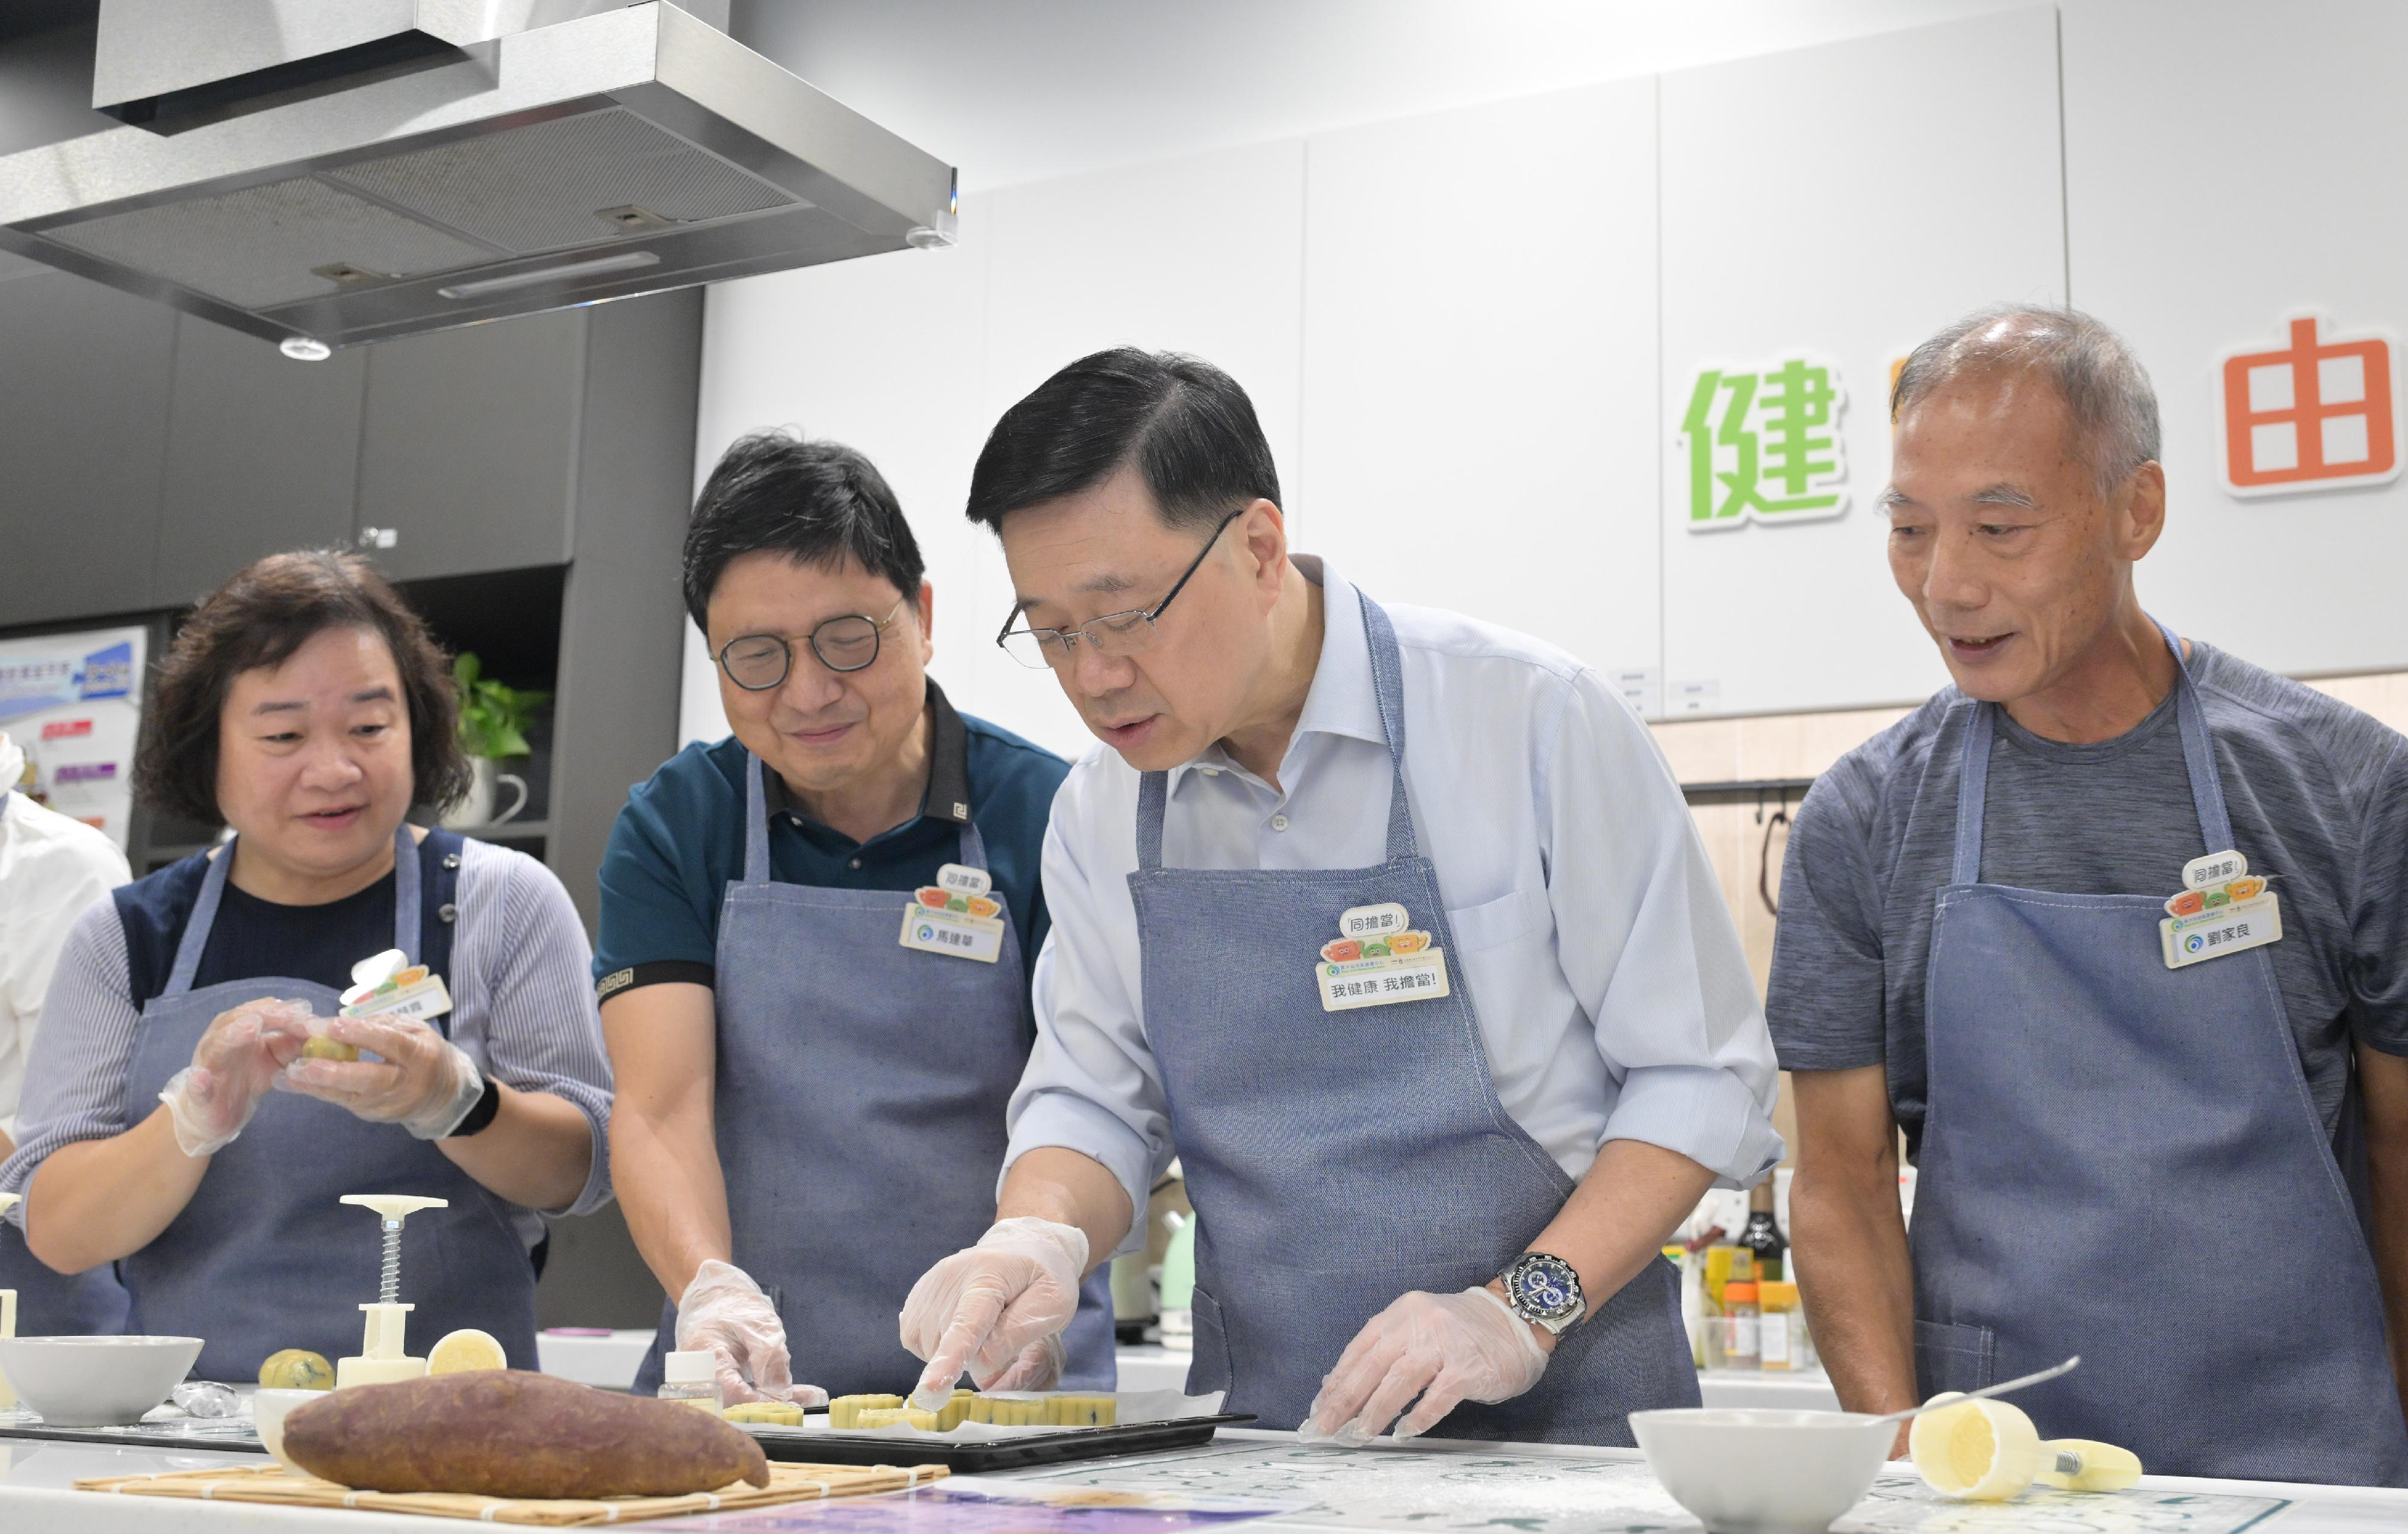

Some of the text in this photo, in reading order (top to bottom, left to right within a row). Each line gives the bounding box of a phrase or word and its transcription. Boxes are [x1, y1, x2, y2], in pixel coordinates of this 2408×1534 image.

[1681, 360, 1840, 520] 健
[2224, 317, 2395, 487] 由
[2208, 924, 2250, 946] 劉家良
[1330, 973, 1436, 998] 我健康 我擔當!
